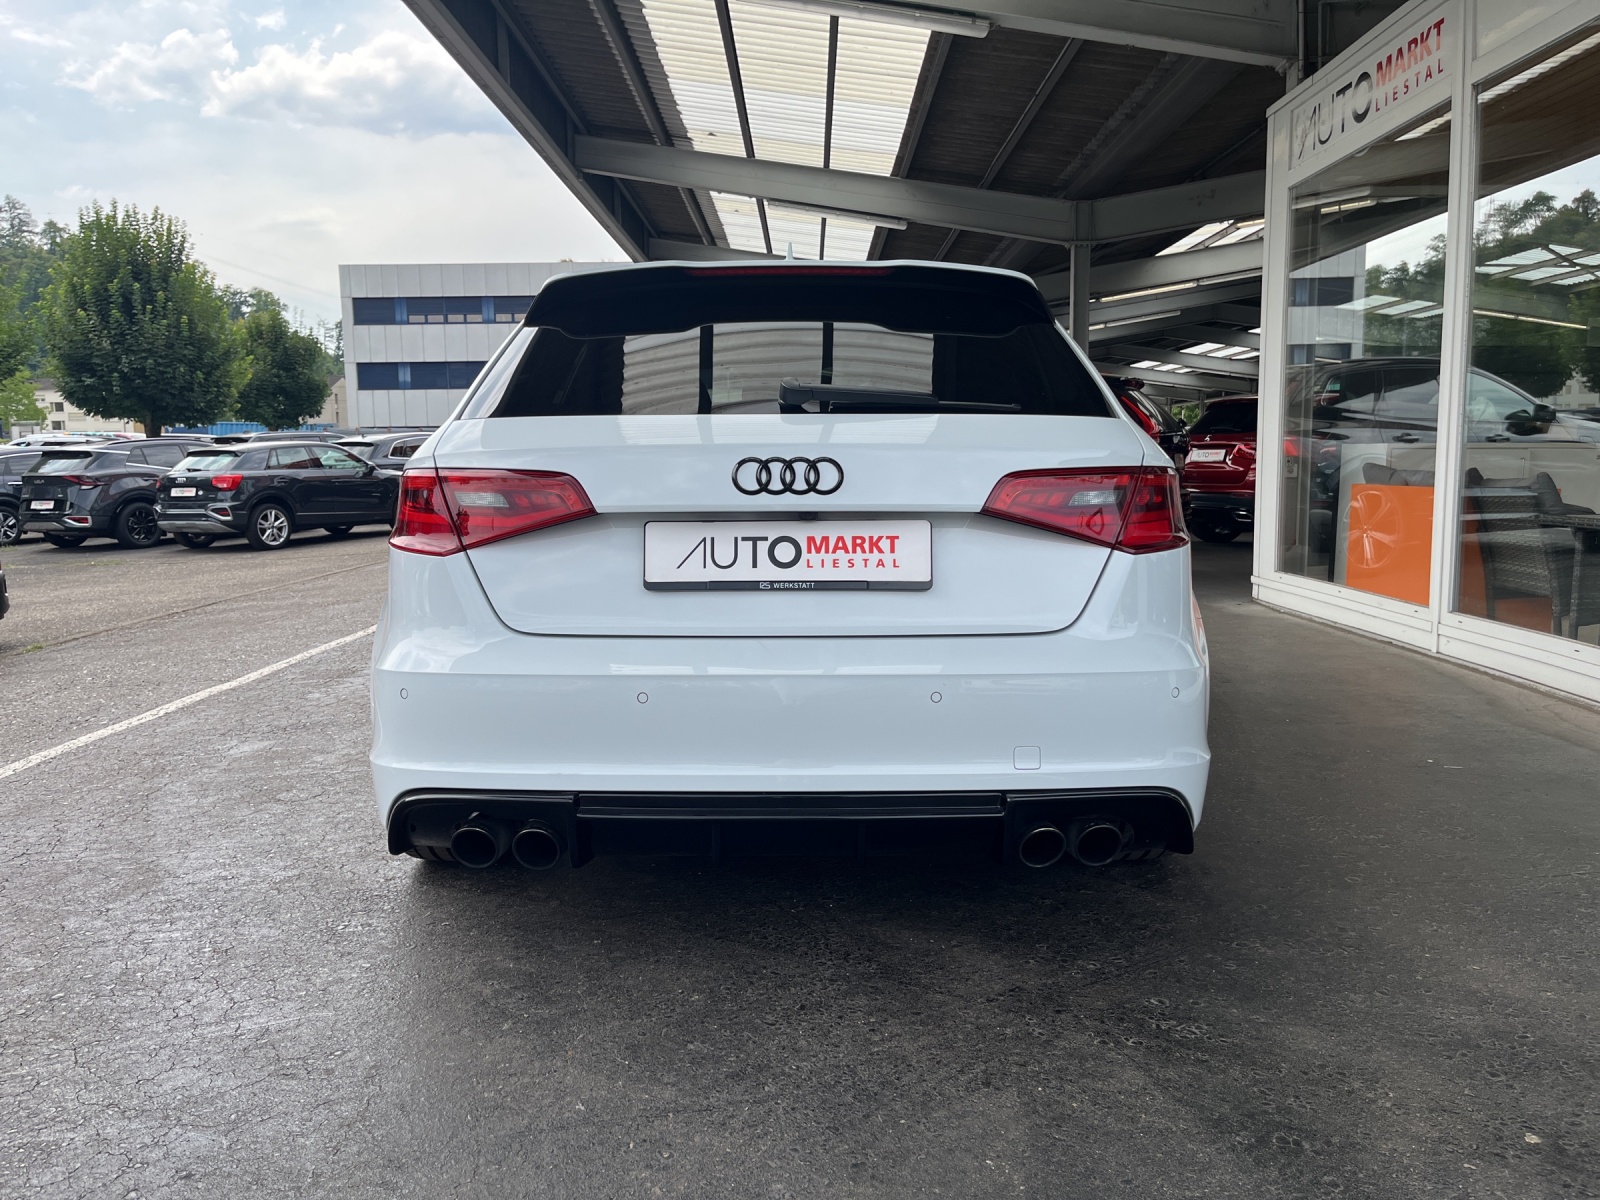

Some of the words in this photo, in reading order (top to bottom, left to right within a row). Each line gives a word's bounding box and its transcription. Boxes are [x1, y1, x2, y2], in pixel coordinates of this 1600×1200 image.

[1298, 71, 1374, 160] AUTO
[1375, 17, 1445, 89] MARKT
[1375, 58, 1444, 113] LIESTAL
[676, 535, 803, 570] AUTO
[806, 535, 900, 555] MARKT
[806, 558, 900, 569] LIESTAL
